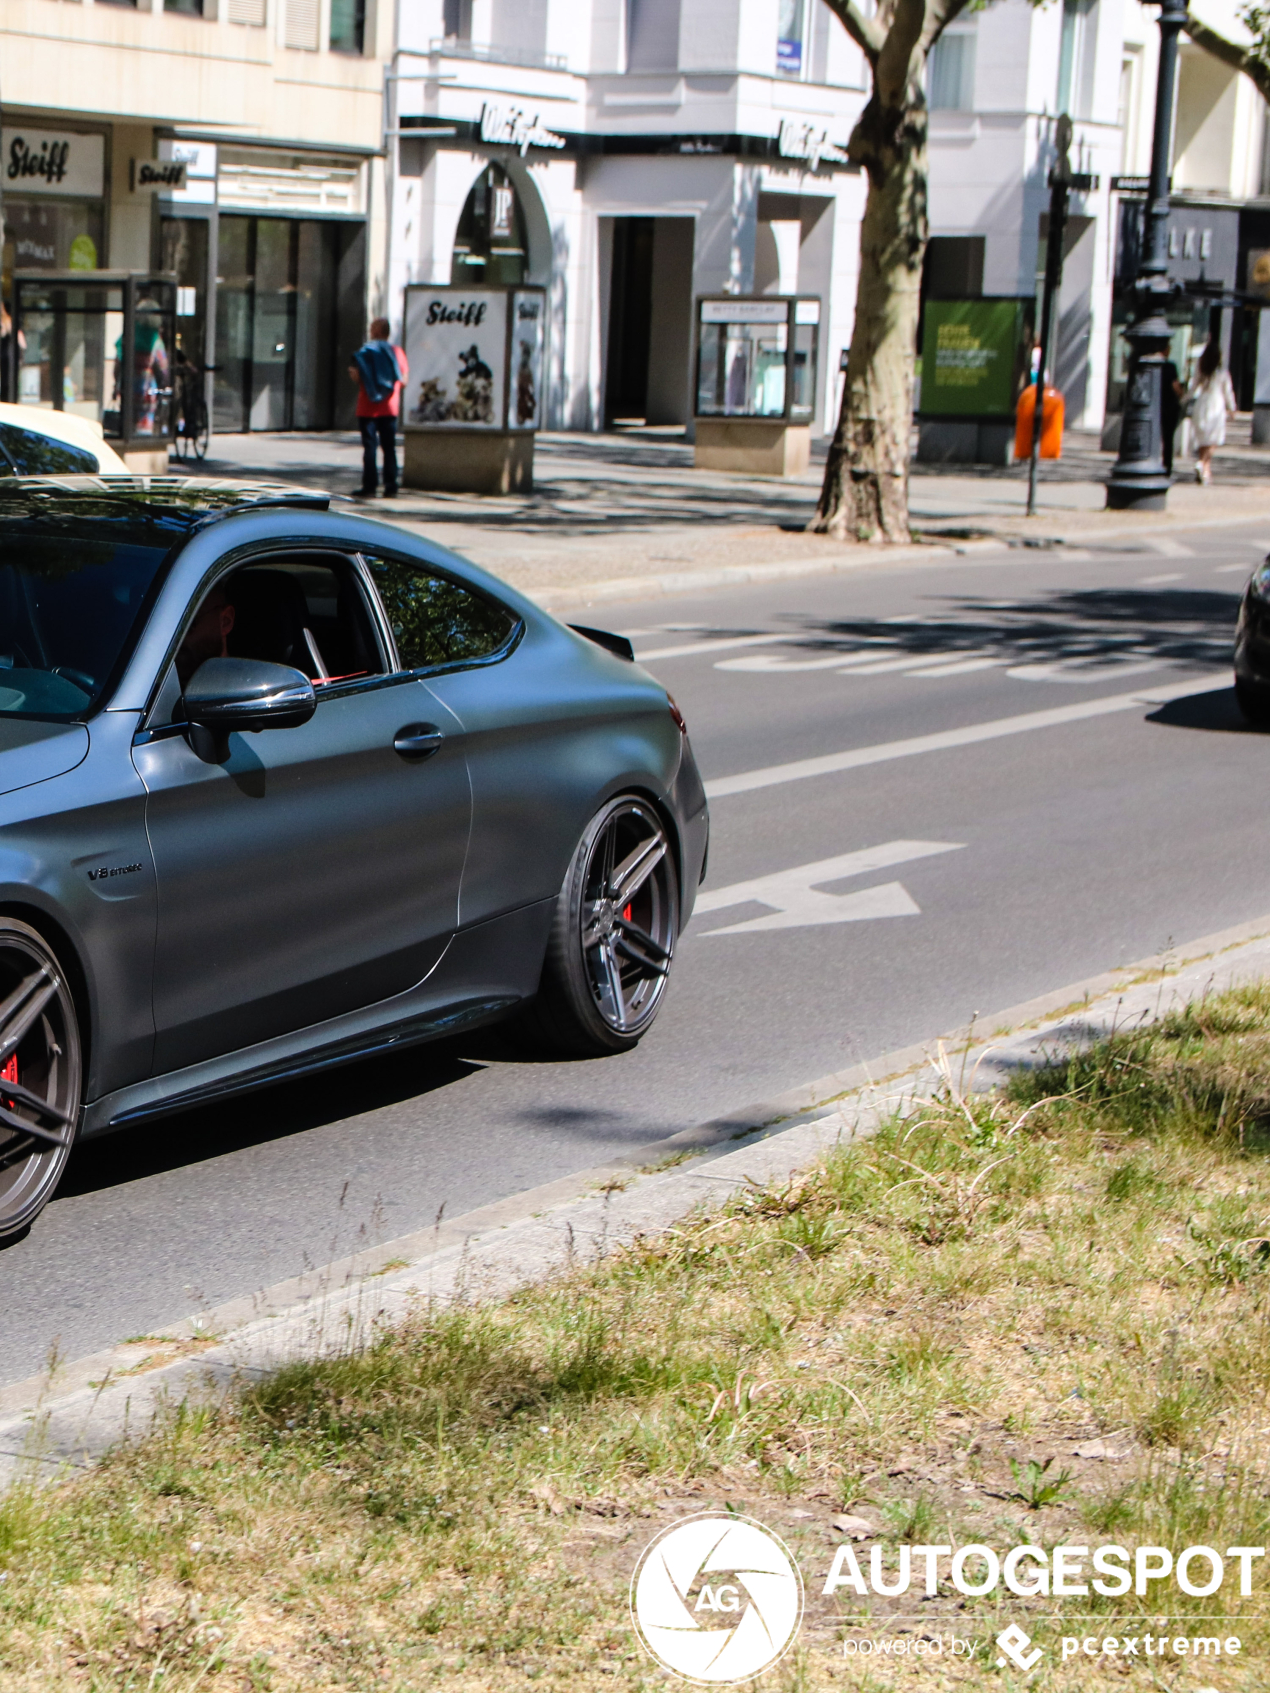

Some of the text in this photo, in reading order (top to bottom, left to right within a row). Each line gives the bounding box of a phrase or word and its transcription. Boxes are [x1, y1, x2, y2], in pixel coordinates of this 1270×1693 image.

[7, 136, 70, 184] Steiff
[138, 163, 184, 185] Steiff
[1167, 226, 1212, 259] LKE
[426, 300, 488, 327] Steiff
[87, 867, 108, 880] V8
